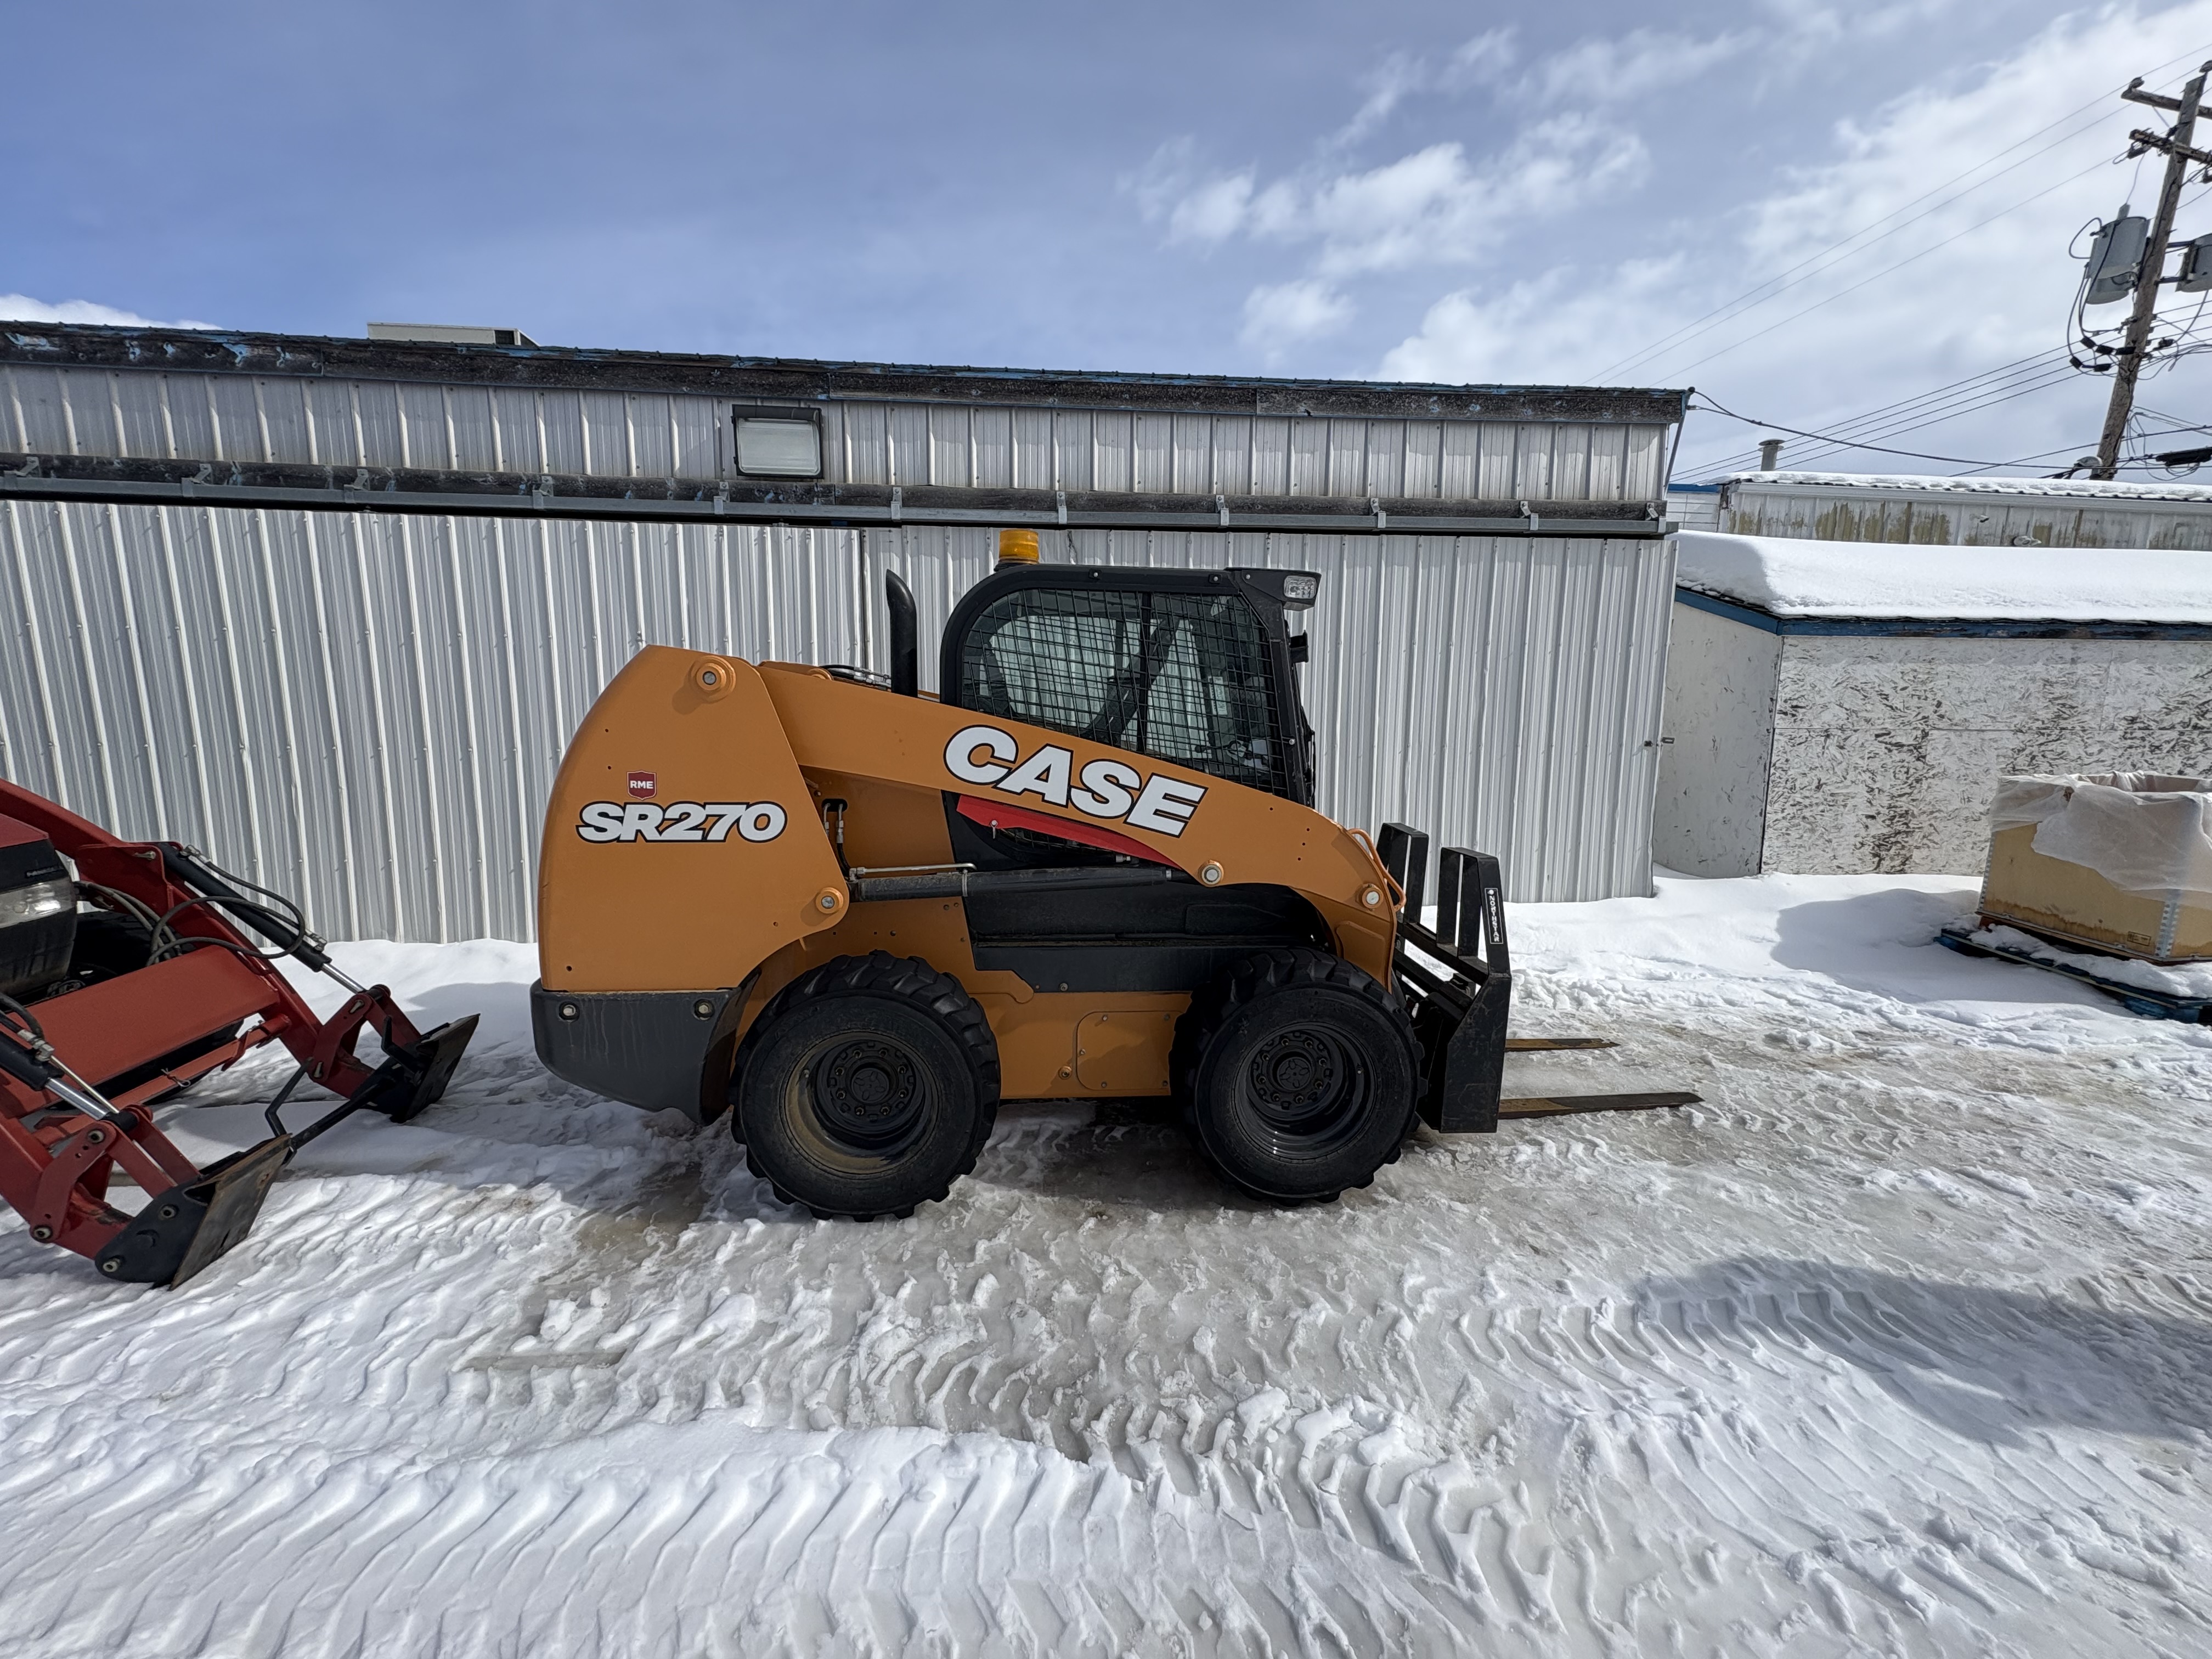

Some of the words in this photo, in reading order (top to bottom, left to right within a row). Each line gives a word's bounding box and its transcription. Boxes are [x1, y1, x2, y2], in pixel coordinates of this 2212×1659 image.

[630, 780, 654, 789] RME
[944, 725, 1208, 837] CASE
[577, 802, 787, 843] SR270
